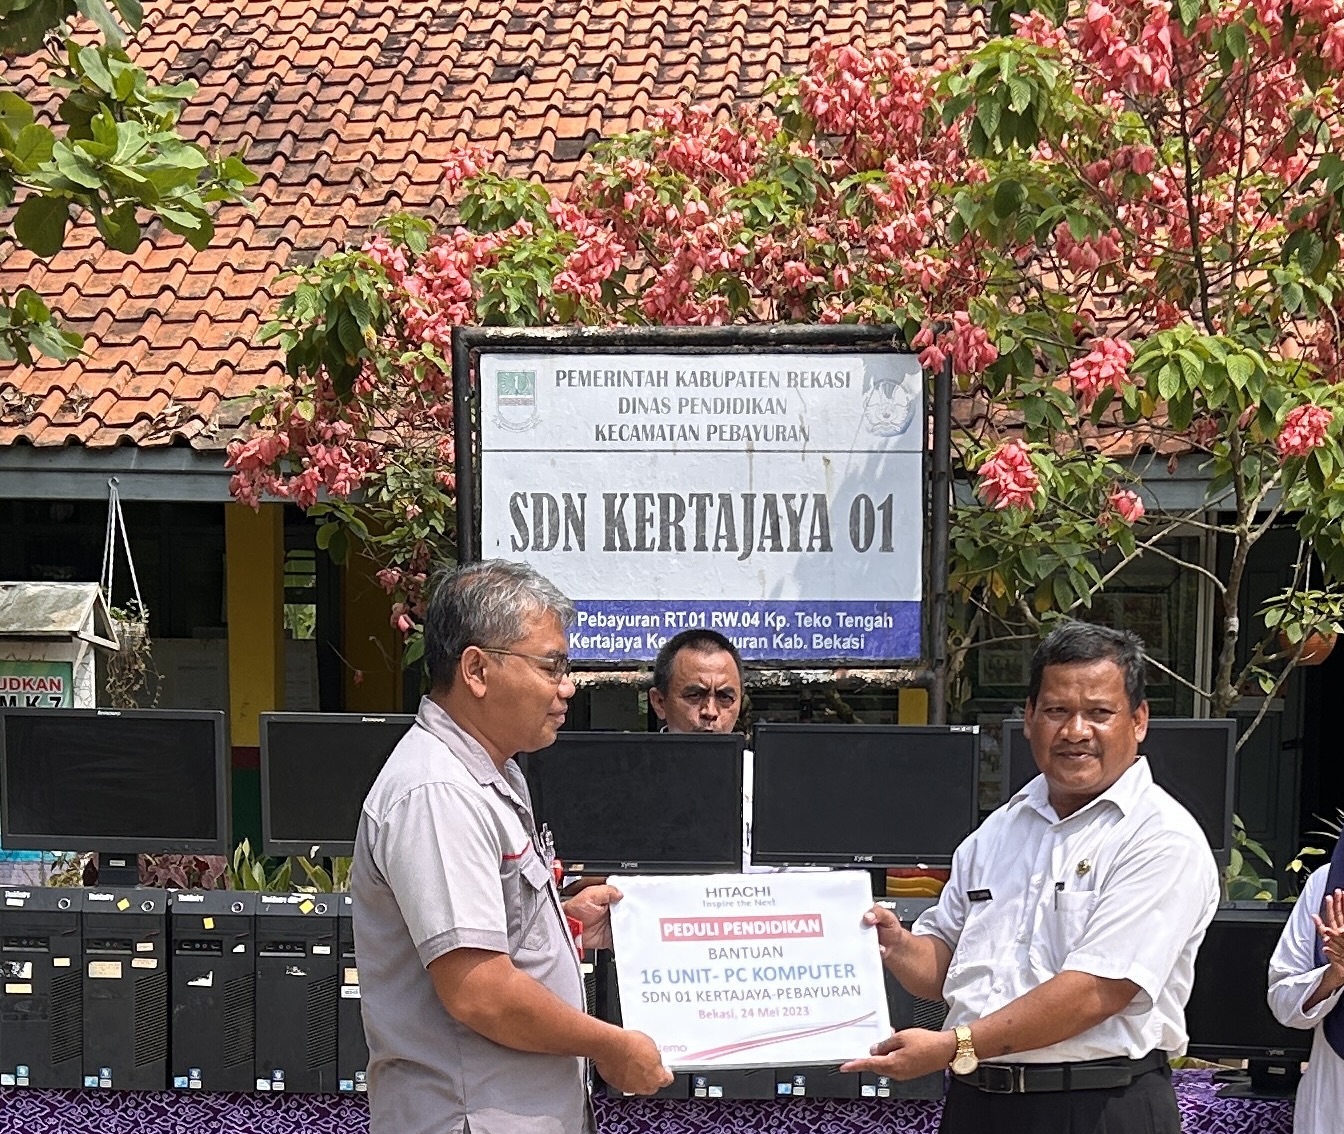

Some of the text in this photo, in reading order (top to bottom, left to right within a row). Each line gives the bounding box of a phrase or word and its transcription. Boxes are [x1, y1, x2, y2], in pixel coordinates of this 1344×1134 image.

[555, 369, 851, 389] PEMERINTAH KABUPATEN BEKASI
[618, 396, 787, 416] DINAS PENDIDIKAN
[594, 423, 810, 443] KECAMATAN PEBAYURAN
[509, 492, 895, 561] SDN KERTAJAYA 01
[577, 611, 893, 631] Pebayuran RT.01 RW.04 Kp. Teko Tengah
[569, 632, 642, 653] Kertajaya
[772, 633, 808, 650] Kab.
[813, 633, 865, 650] Bekasi
[705, 886, 771, 898] HITACHI
[702, 897, 776, 909] Inspire the Next
[663, 918, 821, 937] PEDULI PENDIDIKAN
[708, 945, 784, 960] BANTUAN
[640, 968, 662, 985] 16
[724, 968, 748, 983] PC
[752, 963, 856, 983] KOMPUTER
[641, 984, 862, 1004] SDN 01 KERTAJAYA-PEBAYURAN
[698, 1005, 810, 1021] Bekasi, 24 Mei 2023
